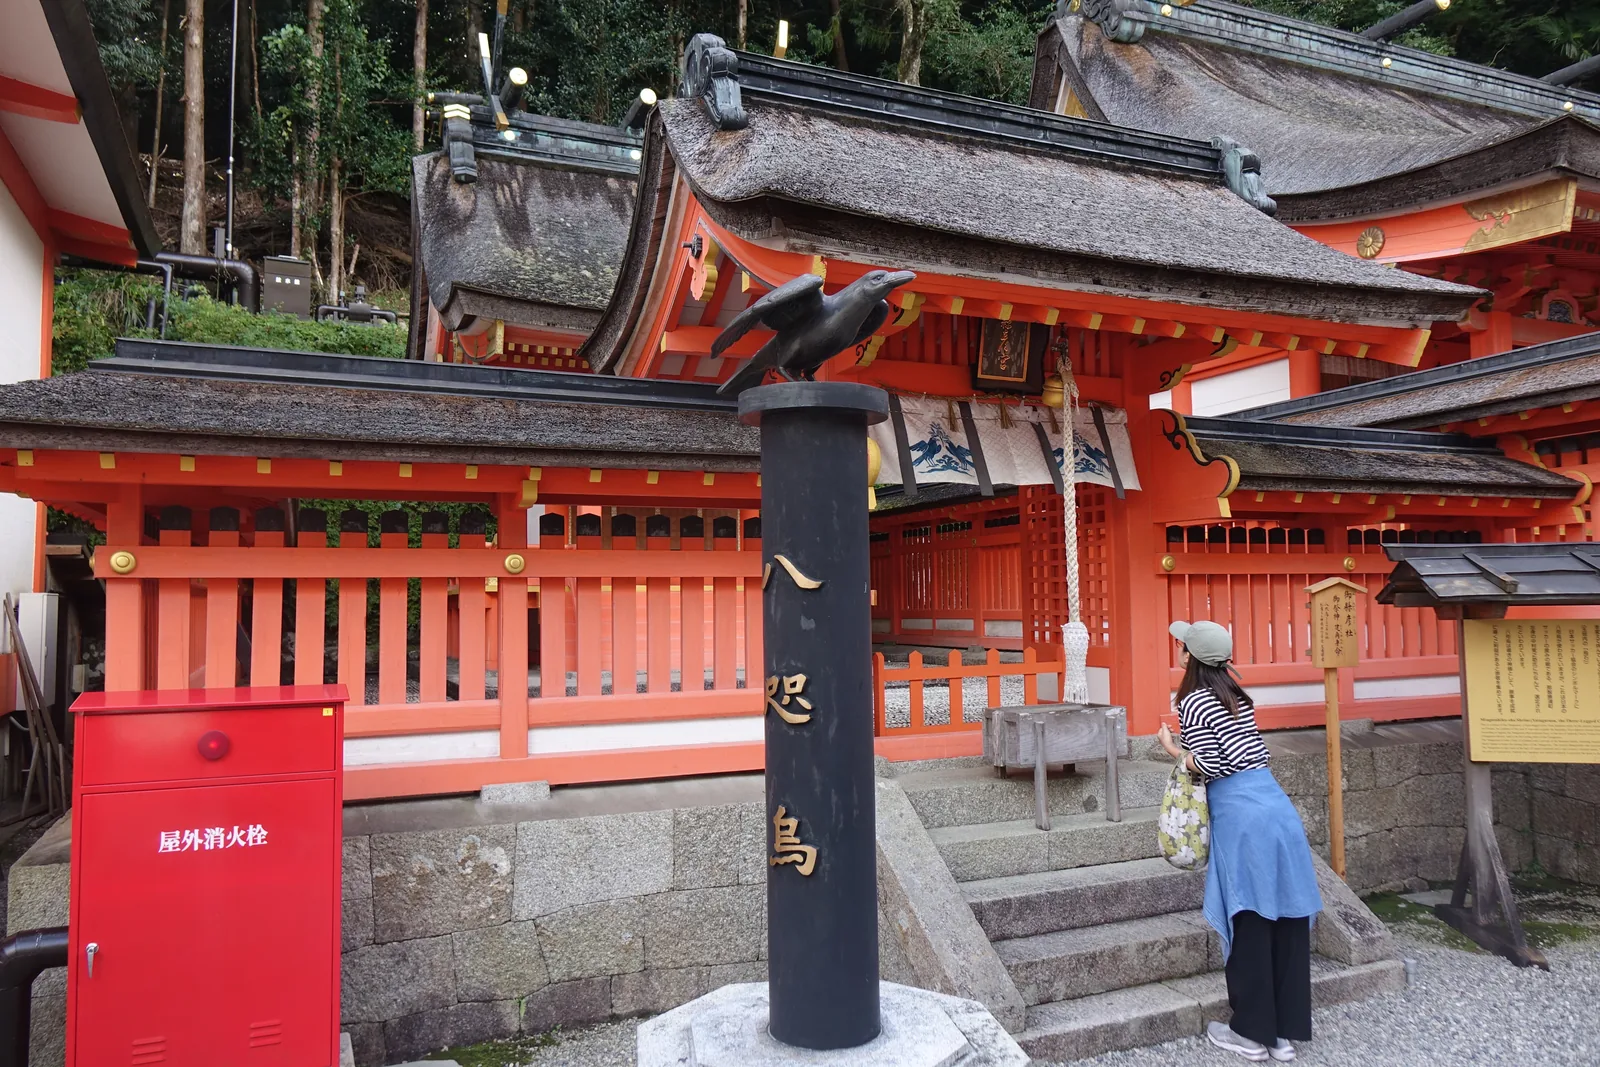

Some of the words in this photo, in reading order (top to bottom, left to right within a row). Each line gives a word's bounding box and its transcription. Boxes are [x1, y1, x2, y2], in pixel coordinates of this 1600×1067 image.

[763, 554, 823, 876] 八咫烏
[158, 824, 268, 853] 屋外消火栓
